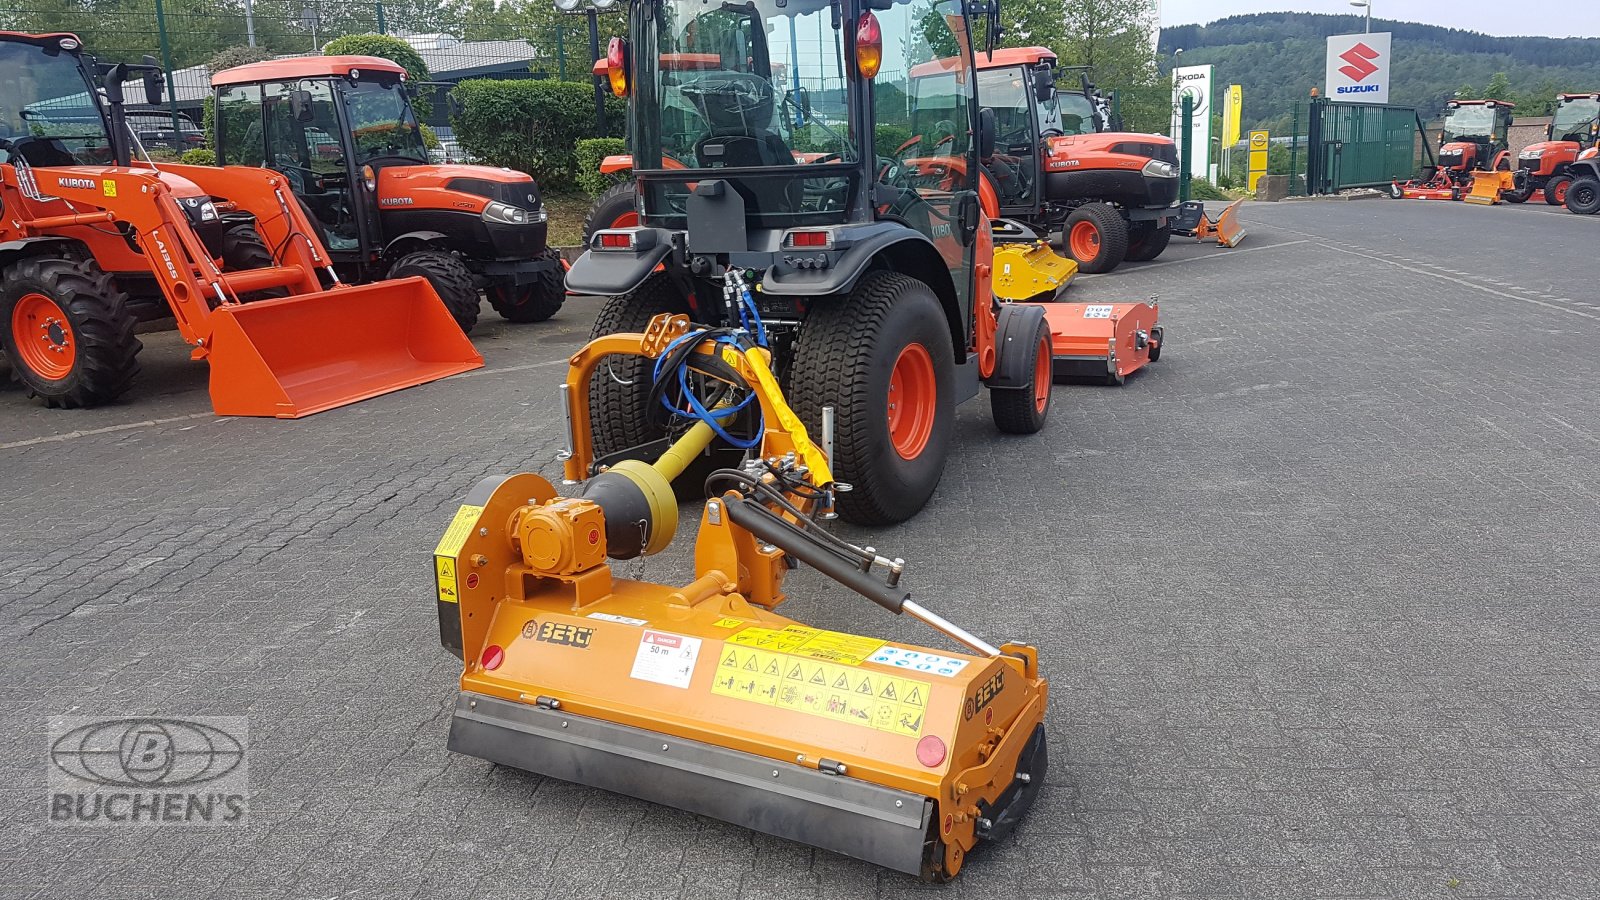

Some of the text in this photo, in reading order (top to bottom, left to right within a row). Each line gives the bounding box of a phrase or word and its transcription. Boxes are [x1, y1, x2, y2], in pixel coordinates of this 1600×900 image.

[1336, 84, 1379, 94] SUZUKI
[1050, 160, 1080, 168] KUBOTA
[58, 177, 96, 189] KUBOTA
[381, 197, 414, 206] KUBOTA
[152, 230, 179, 279] LA1365
[650, 645, 660, 654] 50
